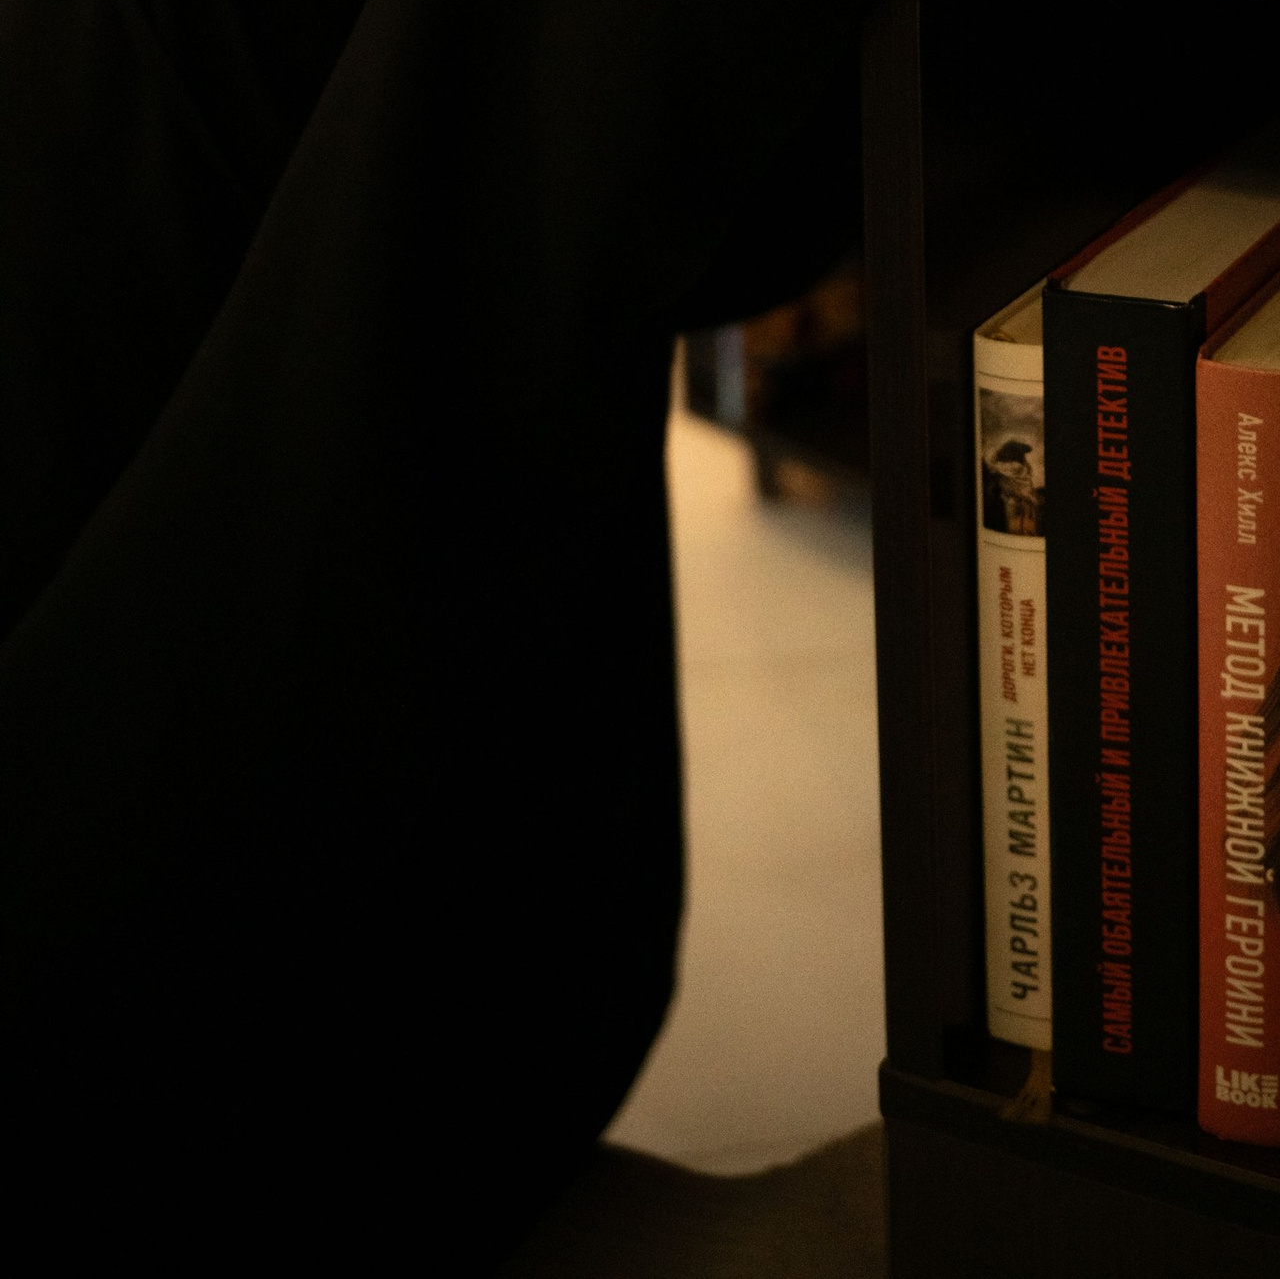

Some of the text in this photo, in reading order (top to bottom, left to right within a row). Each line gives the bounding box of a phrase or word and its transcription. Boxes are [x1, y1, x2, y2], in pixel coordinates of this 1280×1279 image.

[1237, 411, 1264, 545] Алекс Хилл
[1020, 649, 1036, 677] НЕТ
[1091, 343, 1134, 1055] САМЫЙ ОБАЯТЕЛЬНЫЙ И ПРИВЛЕКАТЕЛЬНЫЙ ДЕТЕКТИВ
[1005, 716, 1040, 1001] ЧАРЛЬЗ МАРТИН
[1220, 583, 1275, 1049] МЕТОД КНИЖНОЙ ГЕРОИНИ
[1215, 1064, 1280, 1094] LIKE
[1215, 1084, 1280, 1110] BOOK
